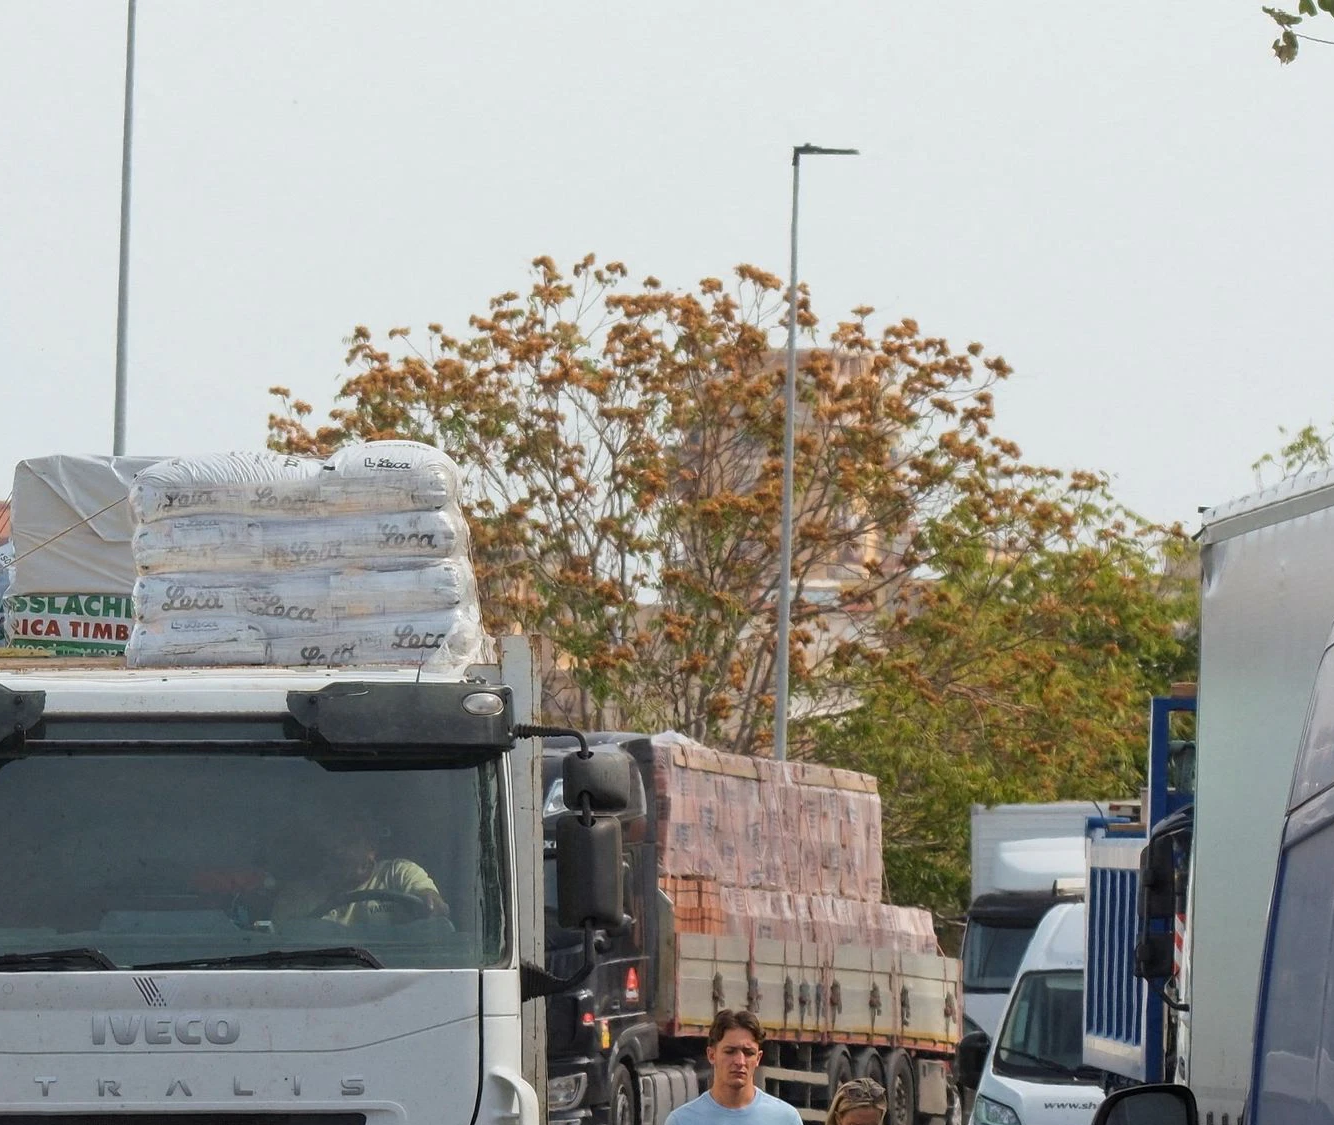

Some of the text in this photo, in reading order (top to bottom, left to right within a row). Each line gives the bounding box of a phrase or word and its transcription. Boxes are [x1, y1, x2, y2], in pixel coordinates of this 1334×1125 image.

[376, 457, 411, 470] Leca
[69, 621, 129, 641] TIMB
[92, 1015, 240, 1046] IVECO
